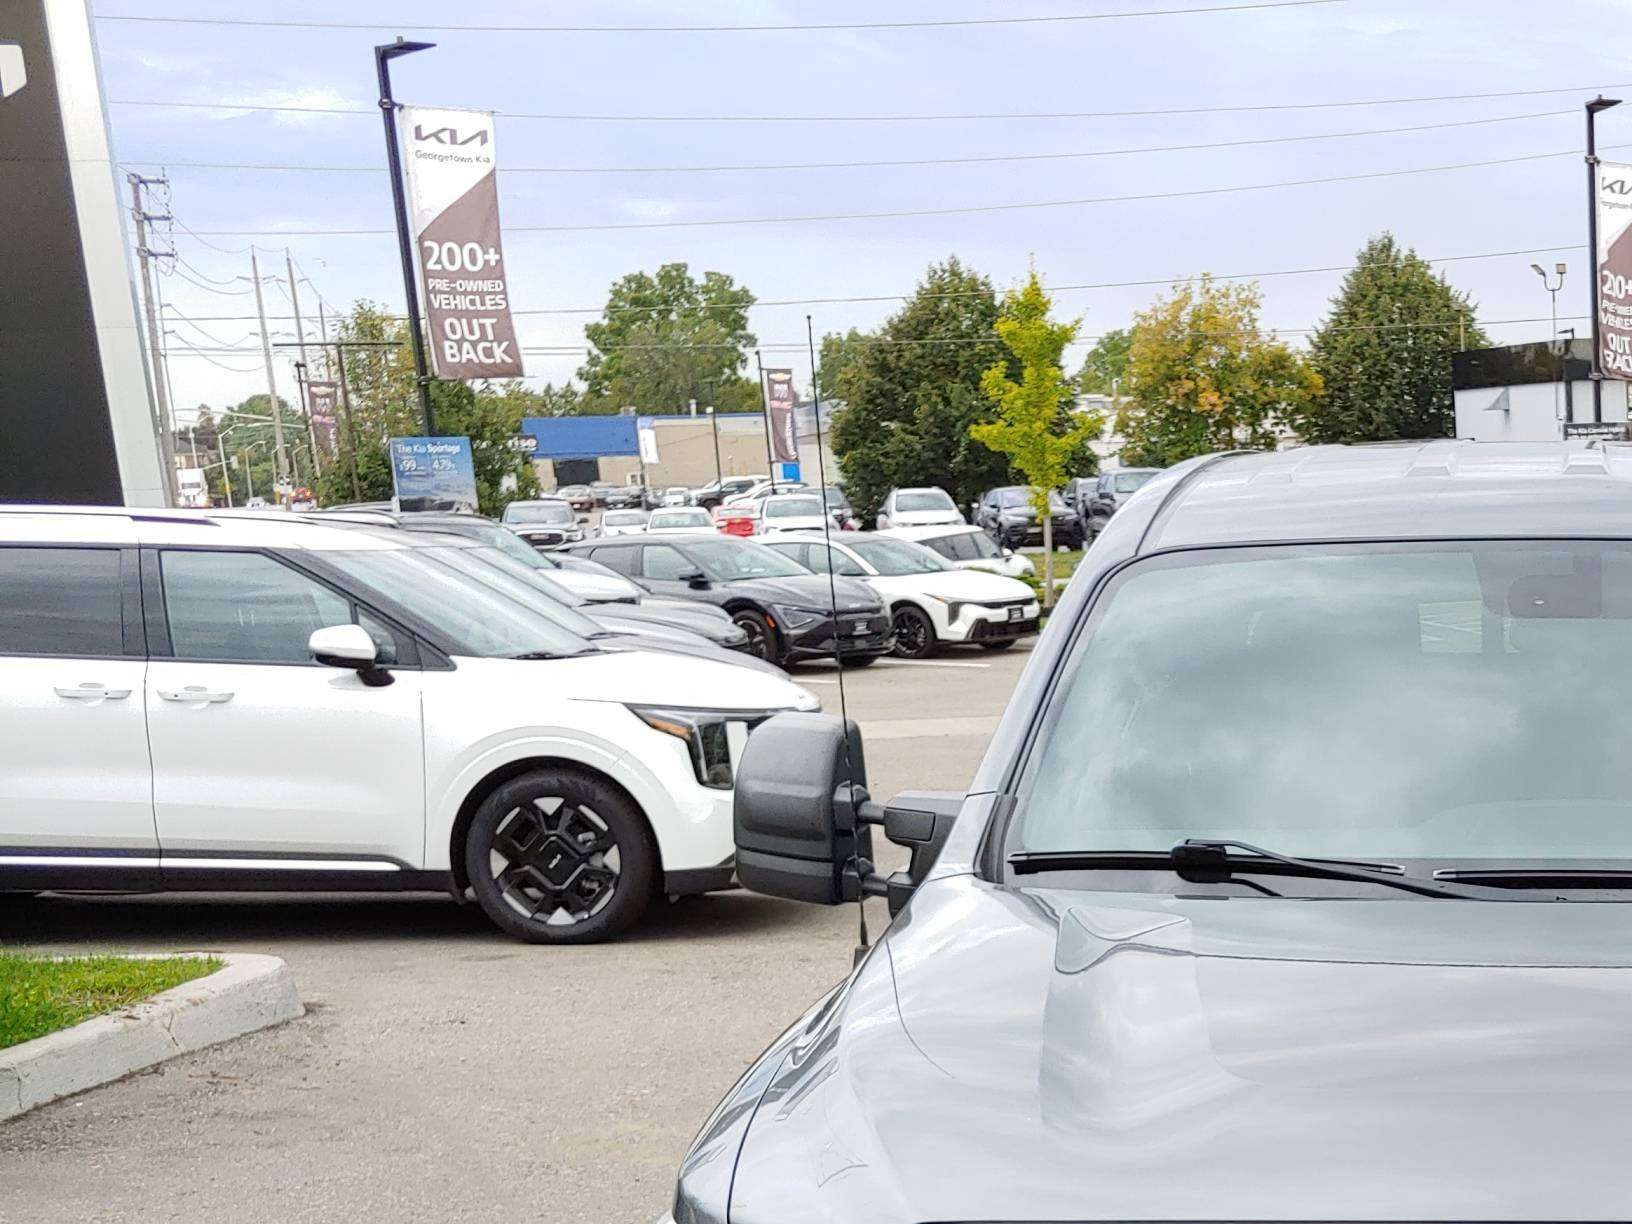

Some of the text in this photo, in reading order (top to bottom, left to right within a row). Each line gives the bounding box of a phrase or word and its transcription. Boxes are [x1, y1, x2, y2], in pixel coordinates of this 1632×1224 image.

[414, 124, 488, 147] KIA
[415, 149, 490, 163] Georgetown Kia
[424, 240, 500, 272] 200+
[428, 278, 504, 292] PRE-OWNED
[430, 293, 507, 310] VEHICLES
[444, 317, 497, 341] OUT
[444, 340, 513, 364] BACK
[1607, 333, 1630, 354] OUT
